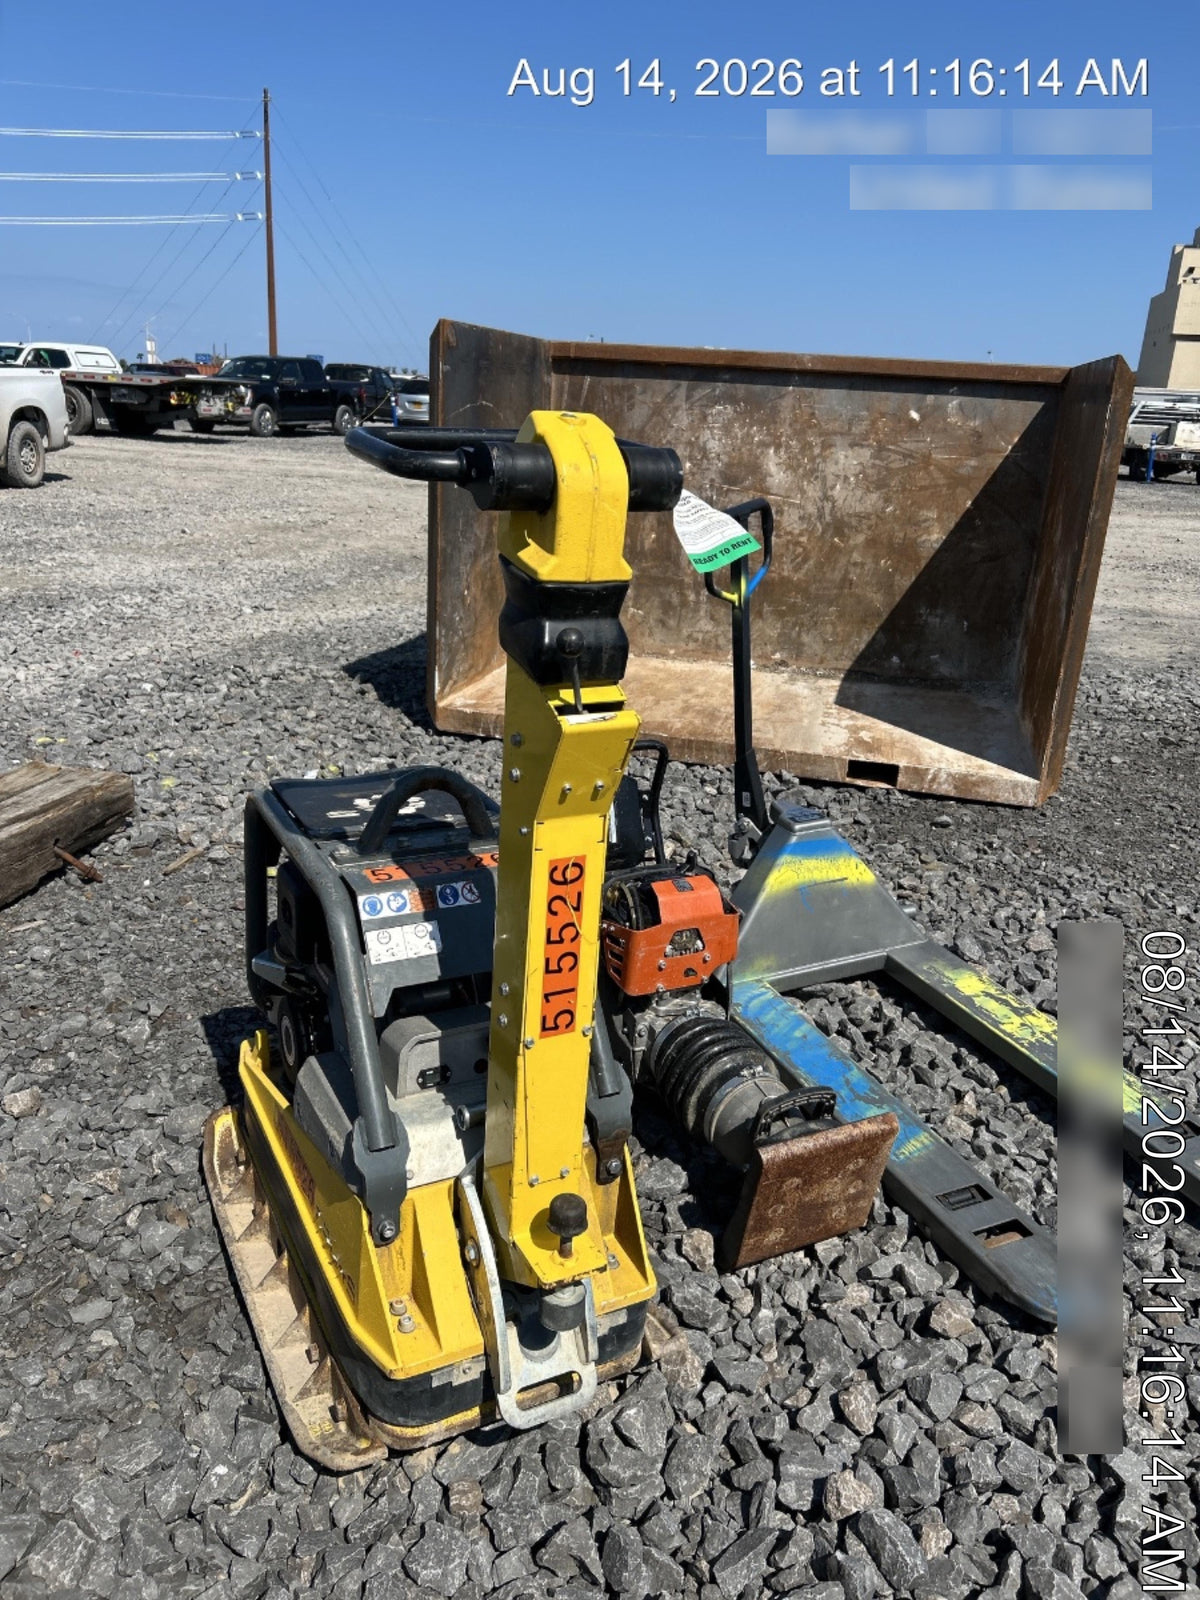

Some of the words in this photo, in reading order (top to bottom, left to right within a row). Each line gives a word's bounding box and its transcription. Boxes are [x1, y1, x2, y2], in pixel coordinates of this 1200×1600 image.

[692, 553, 718, 565] READY
[719, 547, 731, 556] TO
[731, 537, 752, 550] RENT
[541, 861, 584, 1033] 515526
